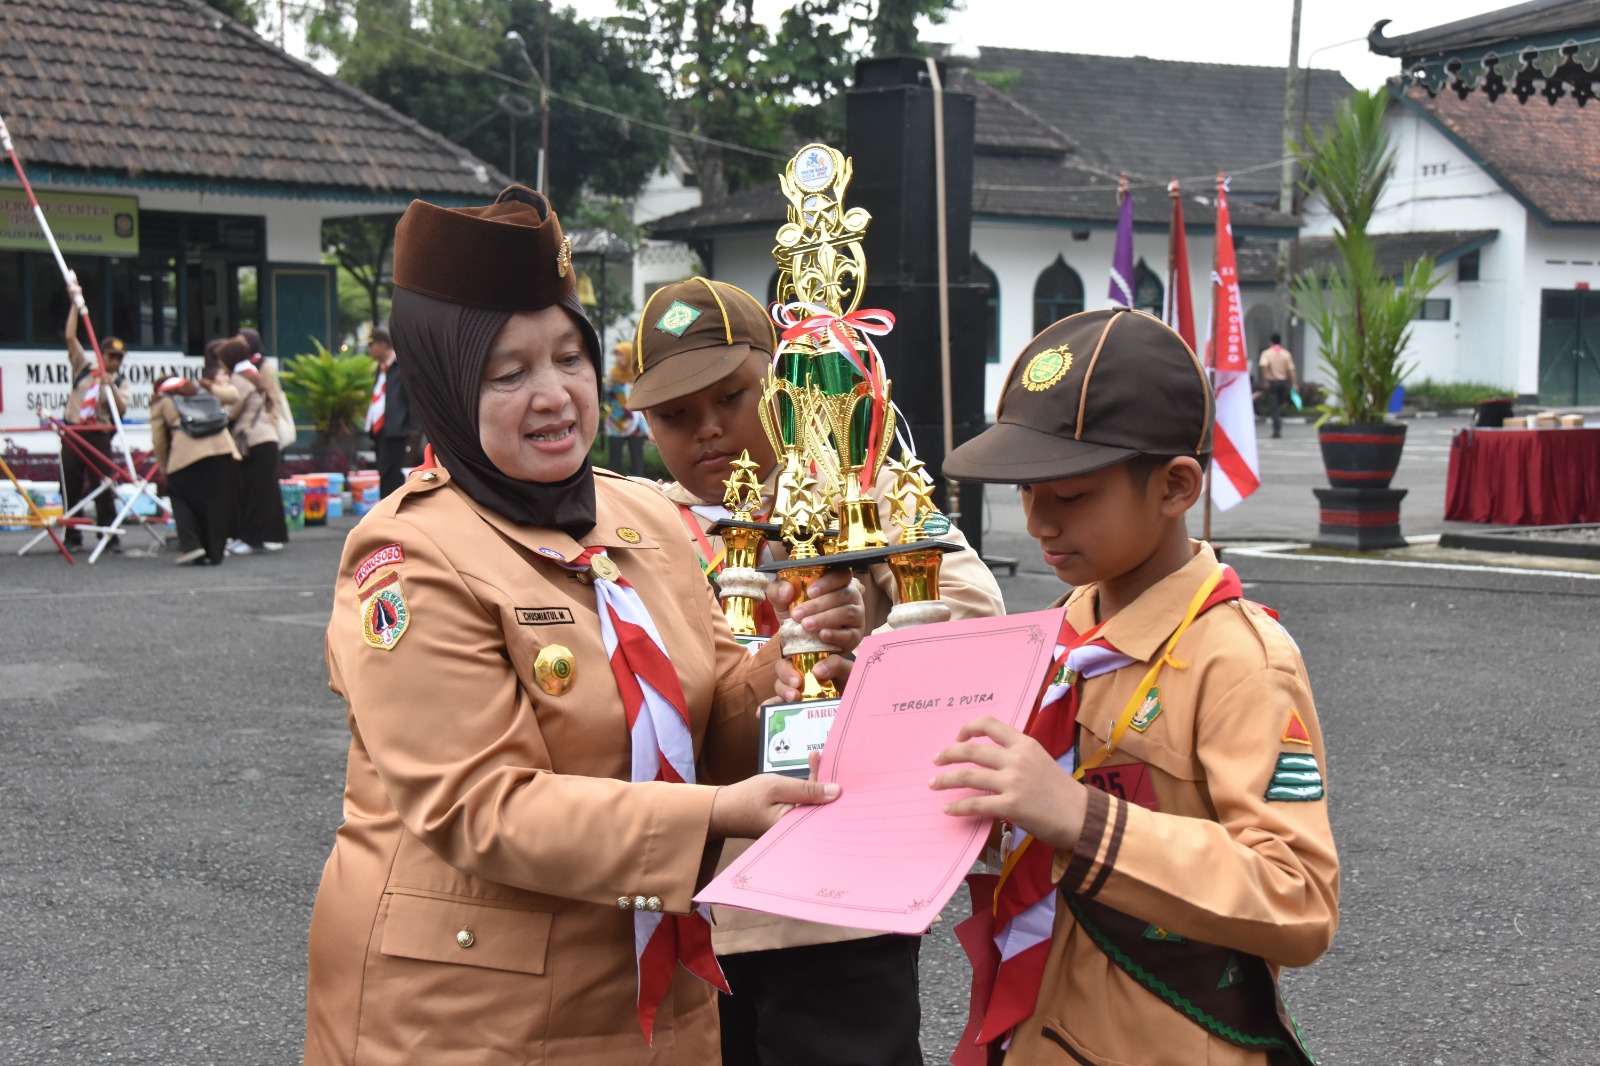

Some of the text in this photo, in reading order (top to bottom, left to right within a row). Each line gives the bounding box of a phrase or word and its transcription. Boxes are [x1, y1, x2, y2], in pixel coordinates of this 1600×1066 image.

[358, 547, 401, 580] WONOSOBO
[892, 692, 994, 712] TERGIAT 2 PUTRA
[807, 707, 839, 719] BARUN
